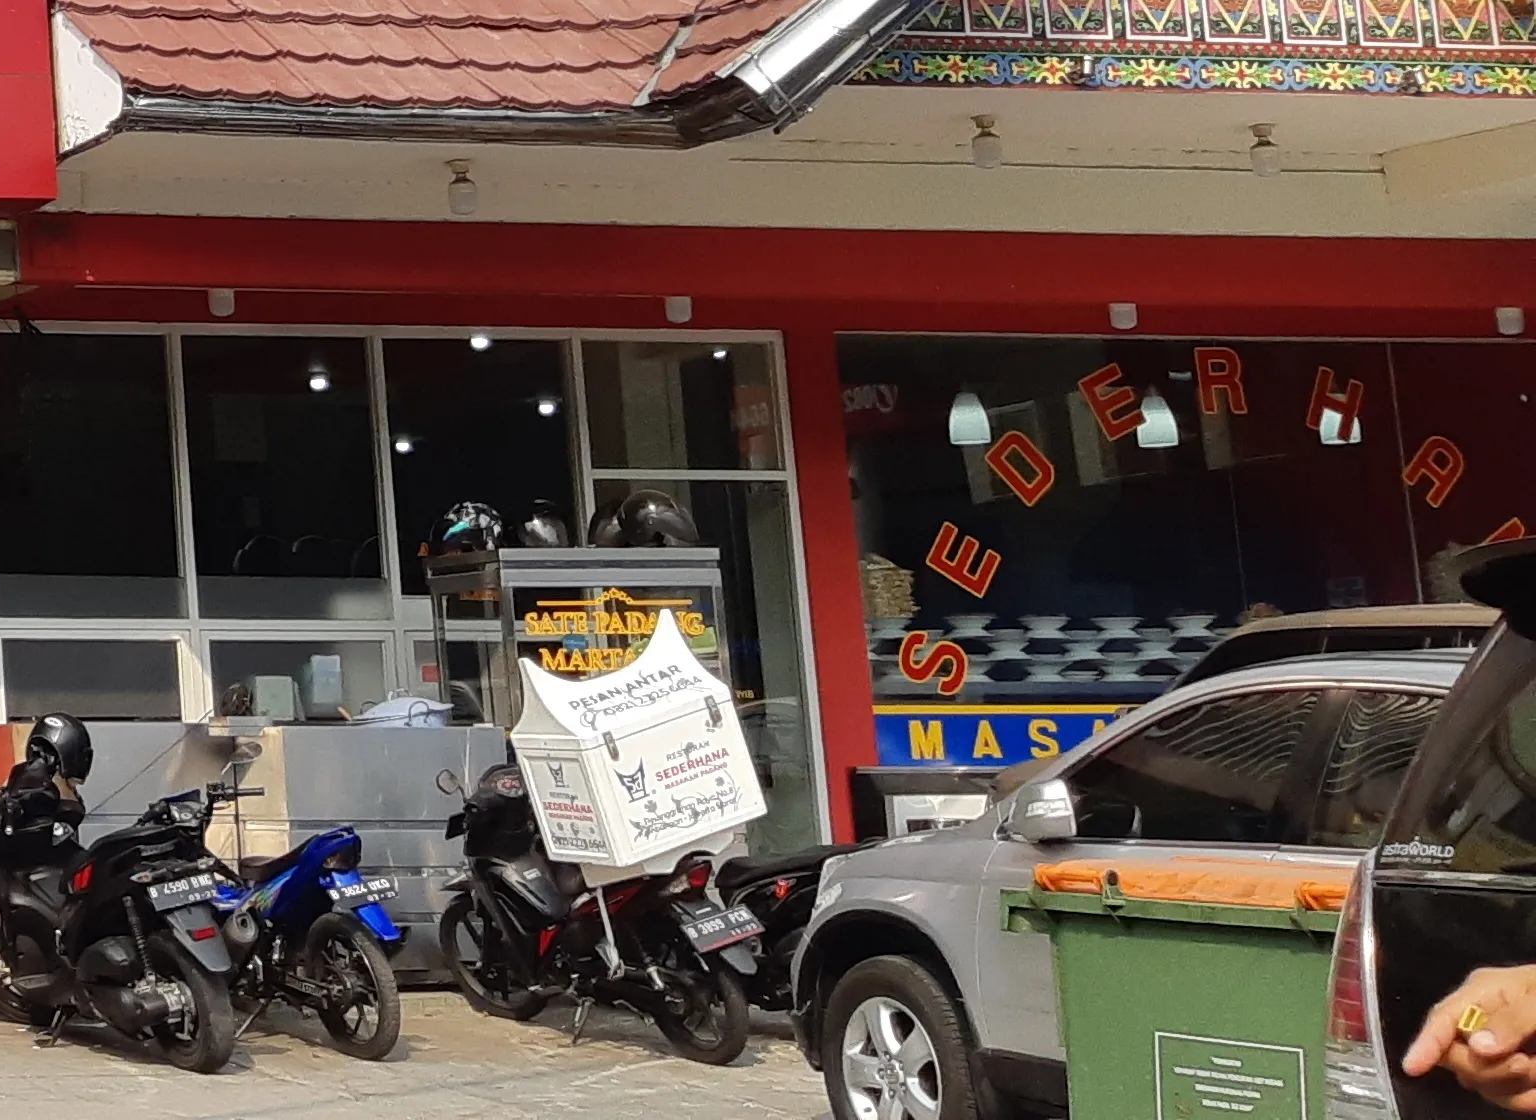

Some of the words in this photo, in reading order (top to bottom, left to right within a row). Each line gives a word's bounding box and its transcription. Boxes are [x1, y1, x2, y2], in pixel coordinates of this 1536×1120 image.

[525, 611, 589, 637] SATE
[592, 610, 706, 638] PADAG
[655, 747, 731, 783] SEDERHANA
